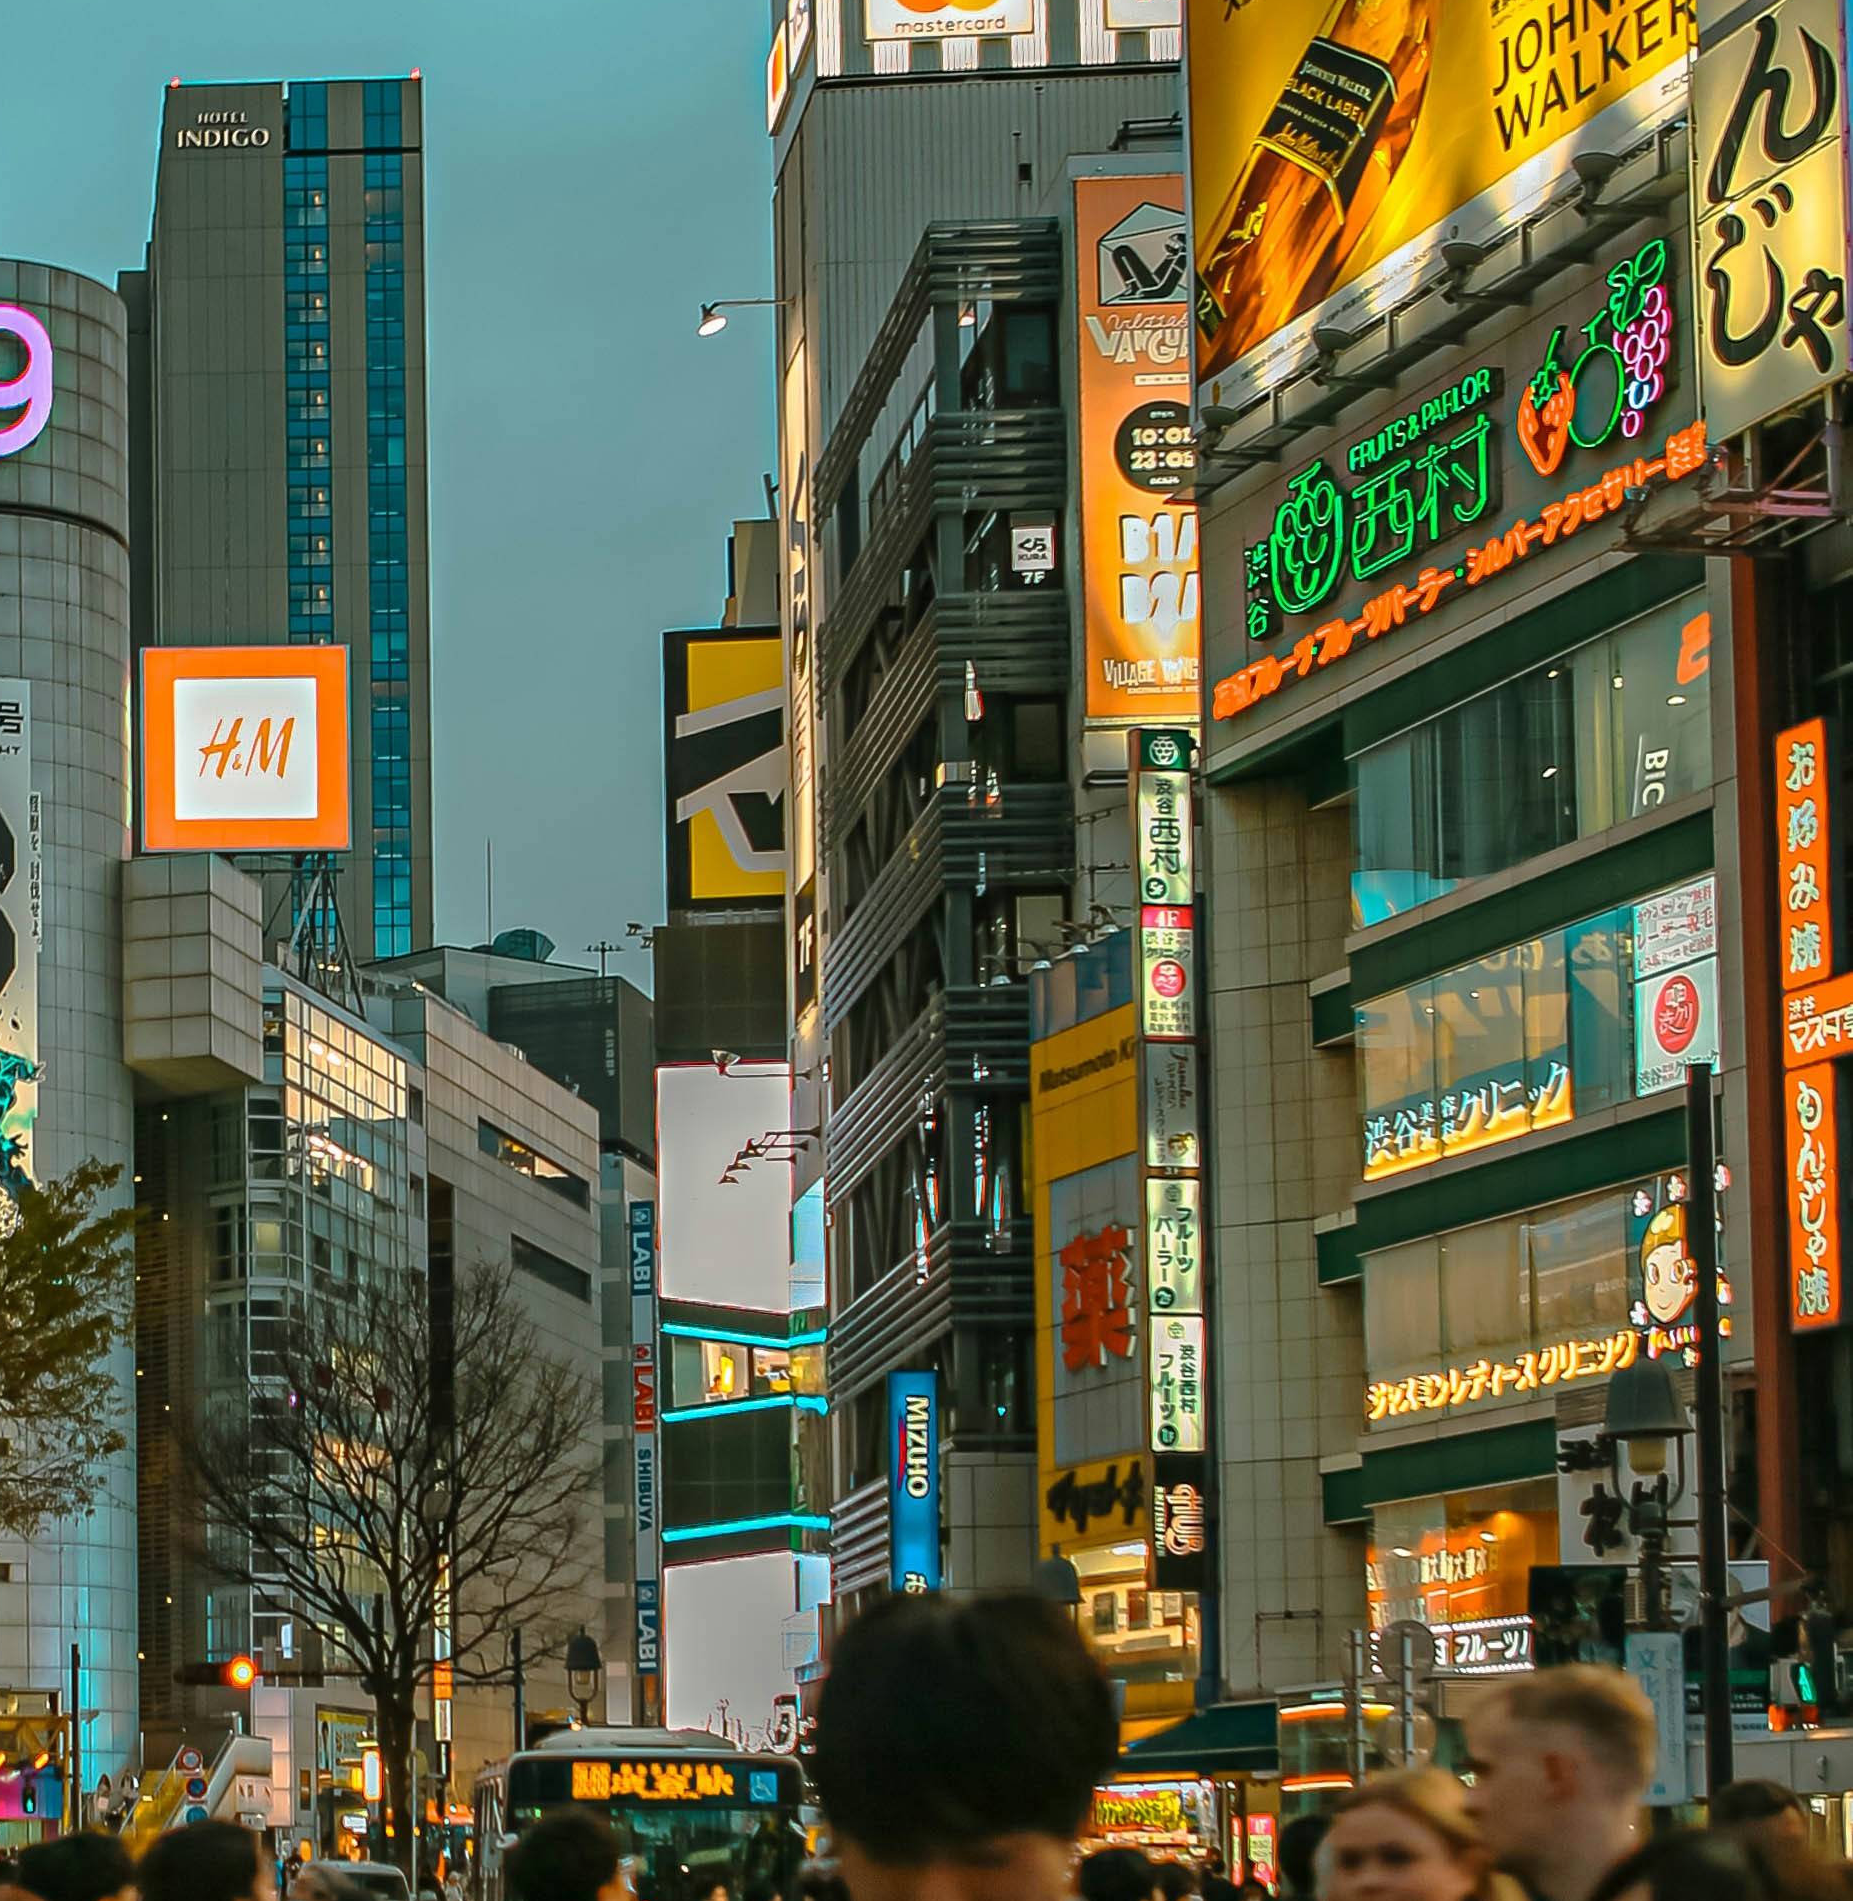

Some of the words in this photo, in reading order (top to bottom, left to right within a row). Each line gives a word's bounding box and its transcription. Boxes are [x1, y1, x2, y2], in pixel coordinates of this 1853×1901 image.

[894, 13, 1008, 35] mastercard
[175, 126, 270, 148] INDIGO
[195, 110, 249, 125] HOTEL
[1351, 411, 1492, 581] 西村
[197, 716, 296, 780] H&M
[632, 1231, 652, 1295] LABI
[1175, 1206, 1194, 1275] フルーツ
[1059, 1222, 1138, 1372] 薬
[633, 1364, 655, 1434] LABI
[1157, 1352, 1176, 1420] フルーツ
[904, 1395, 931, 1499] MIZUHO
[637, 1448, 652, 1532] SHIBUYA
[638, 1608, 657, 1670] LABI
